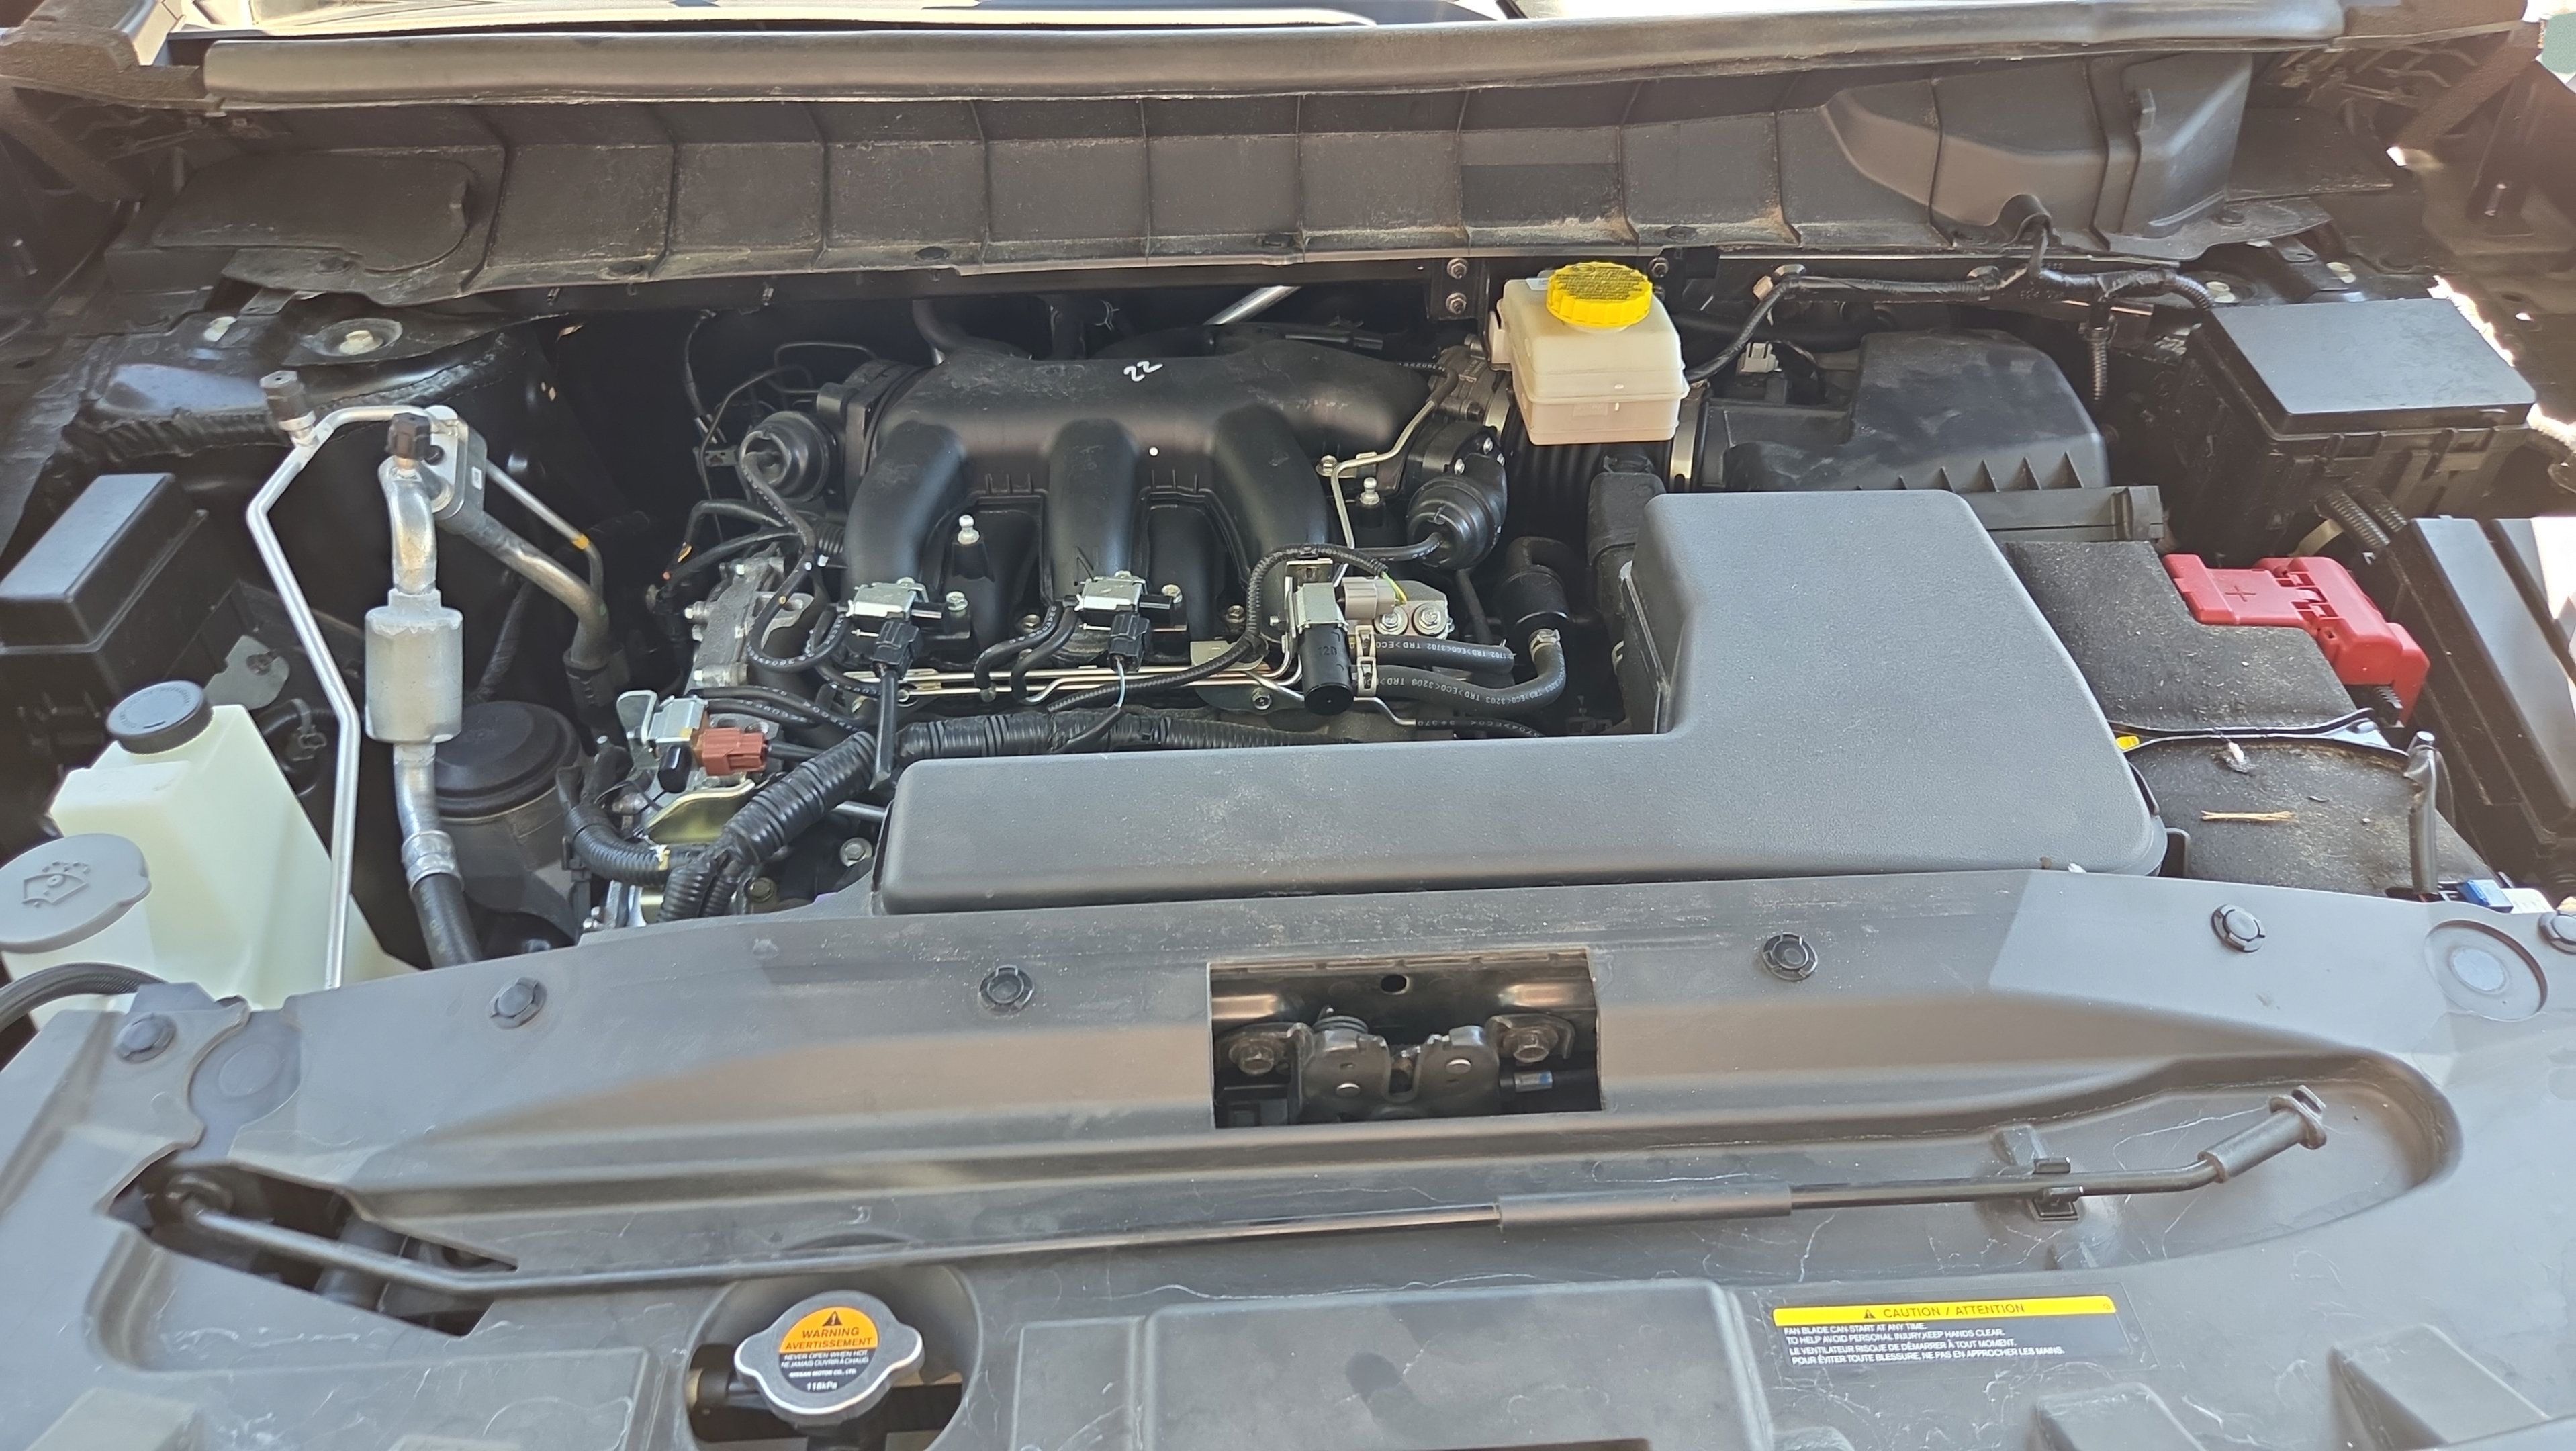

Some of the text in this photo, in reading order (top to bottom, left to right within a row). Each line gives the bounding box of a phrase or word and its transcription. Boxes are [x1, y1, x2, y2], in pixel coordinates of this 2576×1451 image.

[1123, 361, 1163, 382] 22
[1883, 1307, 1940, 1318] CAUTION
[1956, 1303, 2025, 1315] ATTENTION
[802, 1327, 860, 1339] WARNING
[1784, 1326, 1800, 1335] FAN
[1801, 1325, 1829, 1334] BLADE
[1830, 1325, 1847, 1333] CAN
[1849, 1325, 1874, 1333] START
[1876, 1323, 1887, 1332] AT
[1888, 1323, 1904, 1331] ANY
[785, 1337, 872, 1349] AVERTISSEMENT
[1786, 1336, 1798, 1345] TO
[1800, 1335, 1822, 1344] HELP
[1823, 1335, 1847, 1344] AVOID
[1849, 1333, 1894, 1342] PERSONAL
[1945, 1329, 1974, 1338] HANDS
[1975, 1329, 2005, 1337] CLEAR.
[1789, 1347, 1801, 1356] LE
[1802, 1345, 1855, 1355] VENTILATEUR
[1856, 1344, 1887, 1352] RISQUE
[1888, 1343, 1900, 1352] DE
[1901, 1341, 1947, 1351] DÉMARRER
[1954, 1339, 1977, 1348] TOUT
[1791, 1356, 1816, 1365] POUR
[1847, 1354, 1875, 1363] TOUTE
[1935, 1351, 1952, 1359] PAS
[1953, 1350, 1965, 1358] EN
[1966, 1348, 2019, 1358] APPROCHER
[2020, 1347, 2035, 1356] LES
